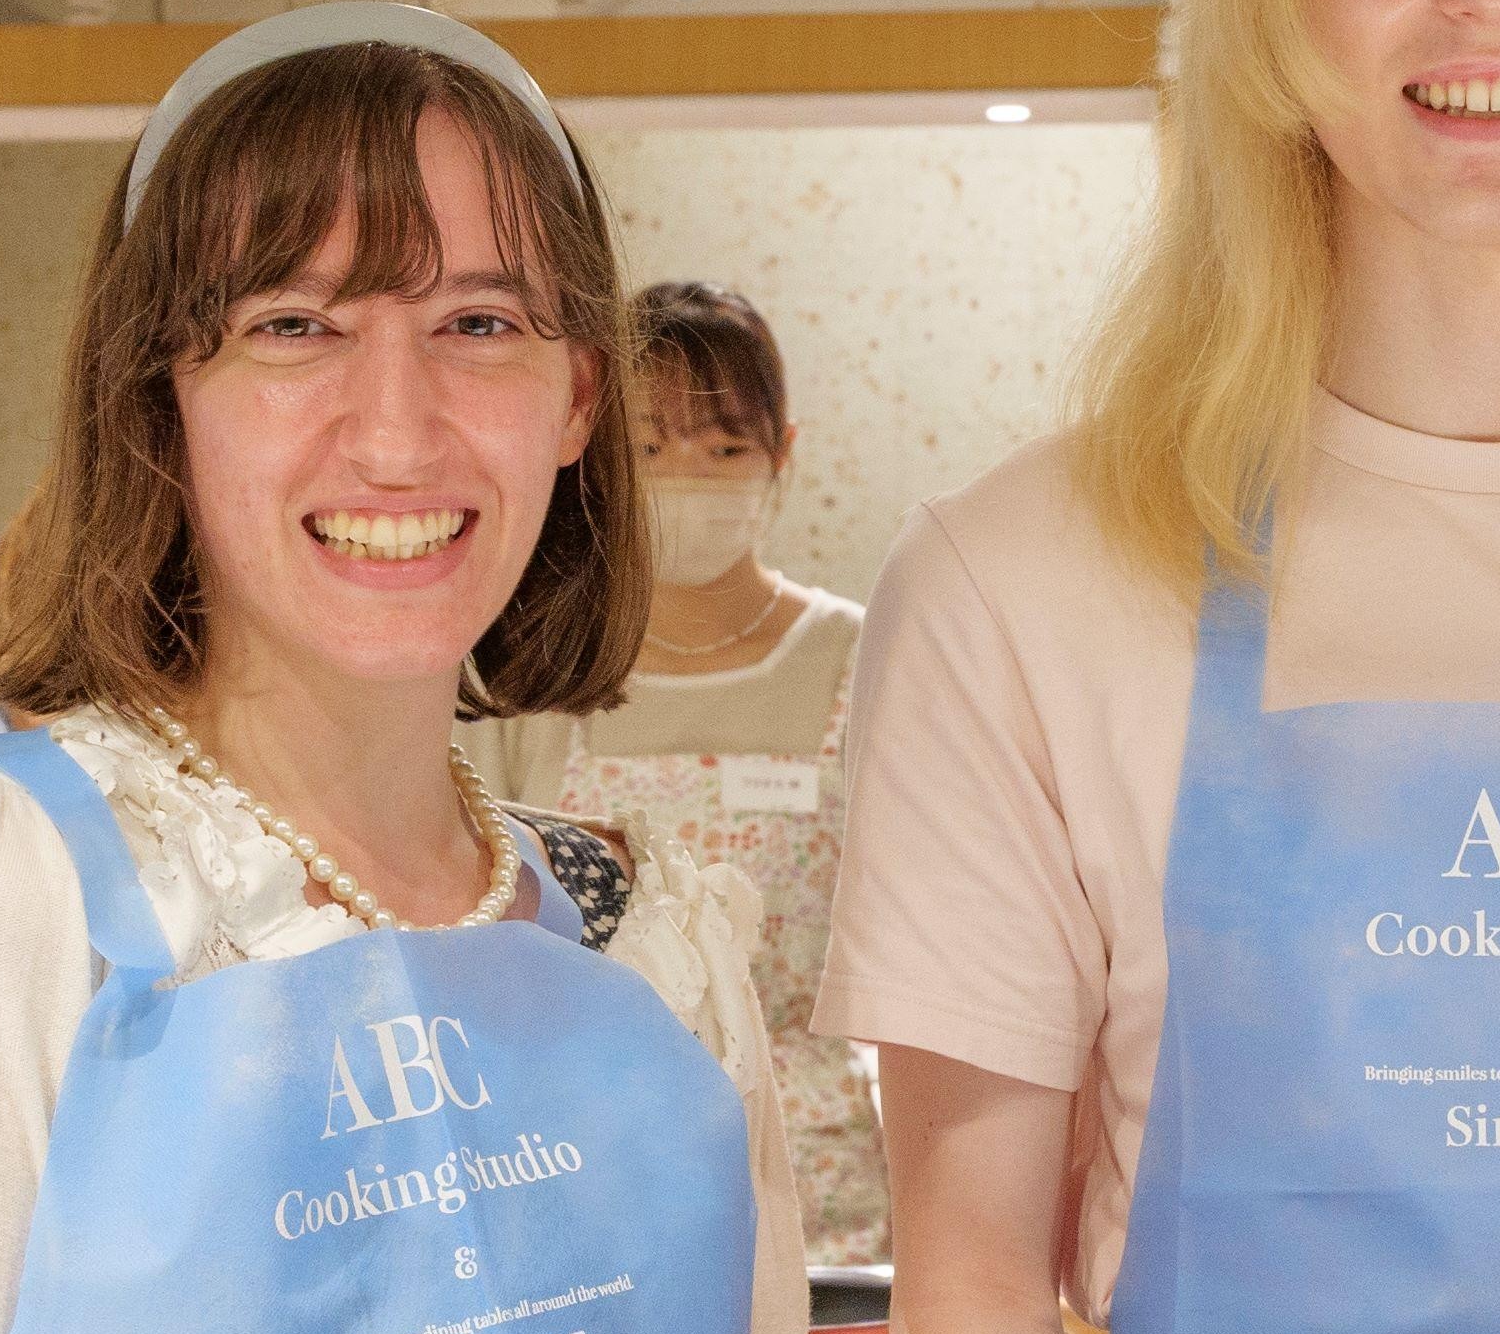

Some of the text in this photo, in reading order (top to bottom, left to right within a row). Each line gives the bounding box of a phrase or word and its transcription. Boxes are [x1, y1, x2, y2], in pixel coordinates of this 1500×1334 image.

[320, 1014, 492, 1140] ABC
[1364, 1065, 1434, 1085] Bringing
[1435, 1066, 1488, 1082] smiles
[274, 1133, 583, 1241] Cooking Studio
[454, 1246, 478, 1280] &
[474, 1307, 514, 1330] tables
[514, 1300, 530, 1319] all
[531, 1289, 578, 1315] around
[577, 1285, 599, 1303] the
